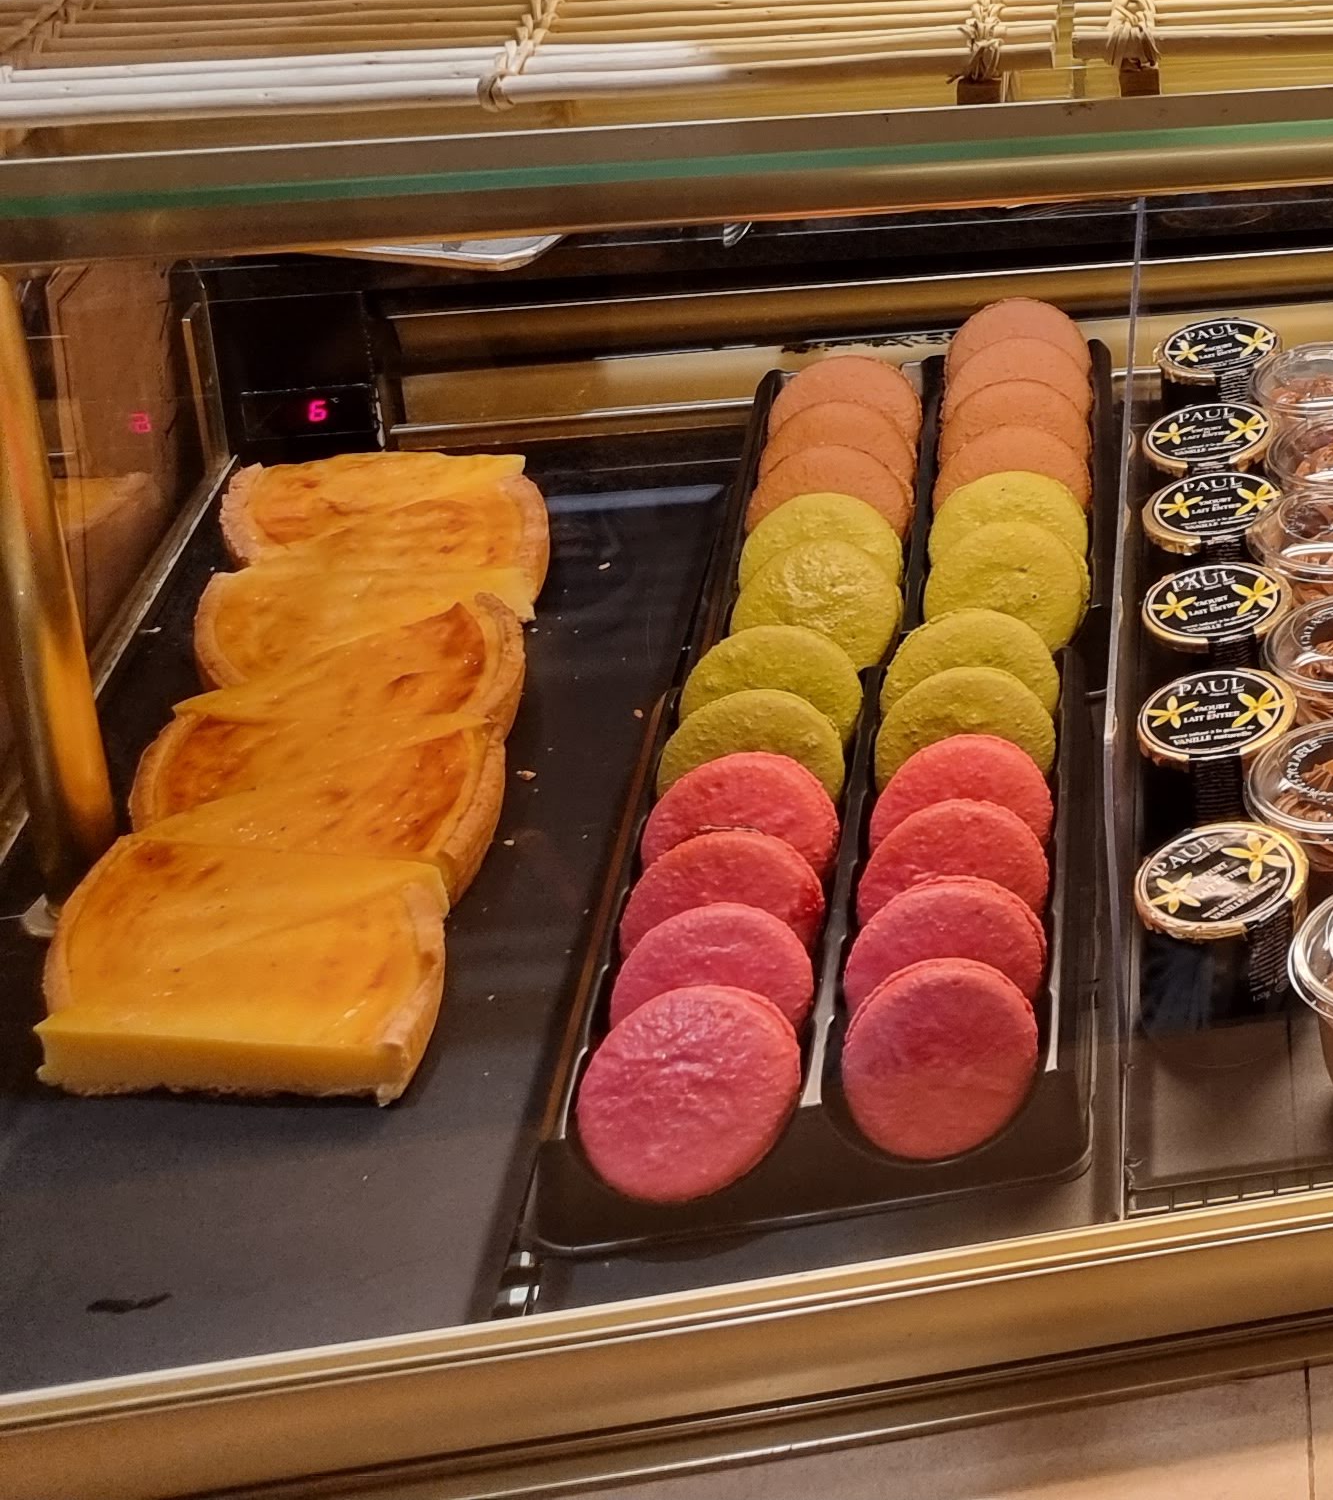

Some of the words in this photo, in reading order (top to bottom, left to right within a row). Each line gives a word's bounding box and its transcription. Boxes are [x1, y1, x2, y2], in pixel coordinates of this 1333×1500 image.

[1184, 324, 1239, 341] PAUL
[309, 400, 327, 421] 6
[1178, 407, 1235, 423] PAUL
[1182, 477, 1243, 493] PAUL
[1177, 677, 1246, 697] PAUL
[1183, 715, 1205, 724] LAIT
[1206, 710, 1240, 721] ENTIER
[1173, 734, 1212, 746] VANILLE
[1152, 837, 1218, 877] PAUL
